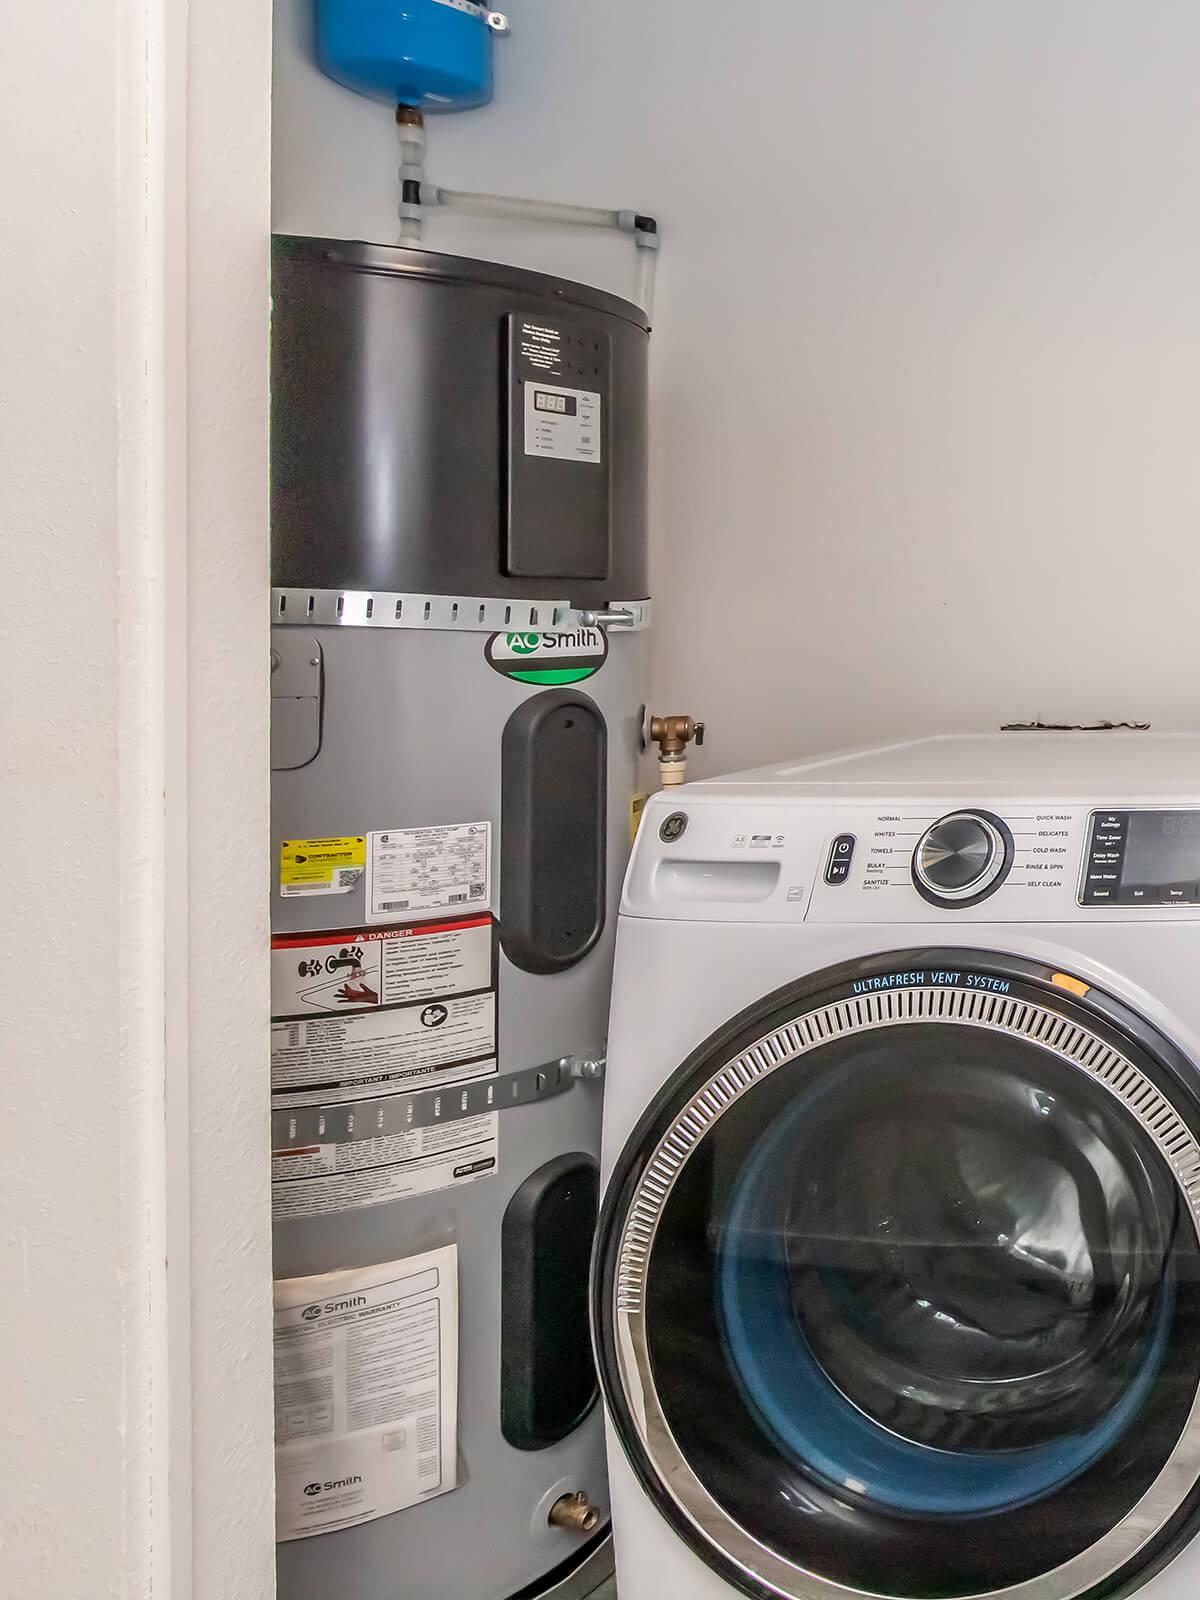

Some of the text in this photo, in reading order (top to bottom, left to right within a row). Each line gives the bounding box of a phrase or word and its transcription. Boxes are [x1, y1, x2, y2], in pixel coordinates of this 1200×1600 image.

[542, 629, 597, 648] Smith
[368, 929, 413, 940] DANGER
[853, 972, 1010, 993] ULTRAFRESH VENT SYSTEM
[339, 1076, 383, 1087] IMPORTANT
[389, 1067, 436, 1080] IMPORTANTE
[324, 1295, 367, 1314] Smith
[358, 1302, 401, 1318] WARRANTY
[323, 1475, 362, 1491] Smith
